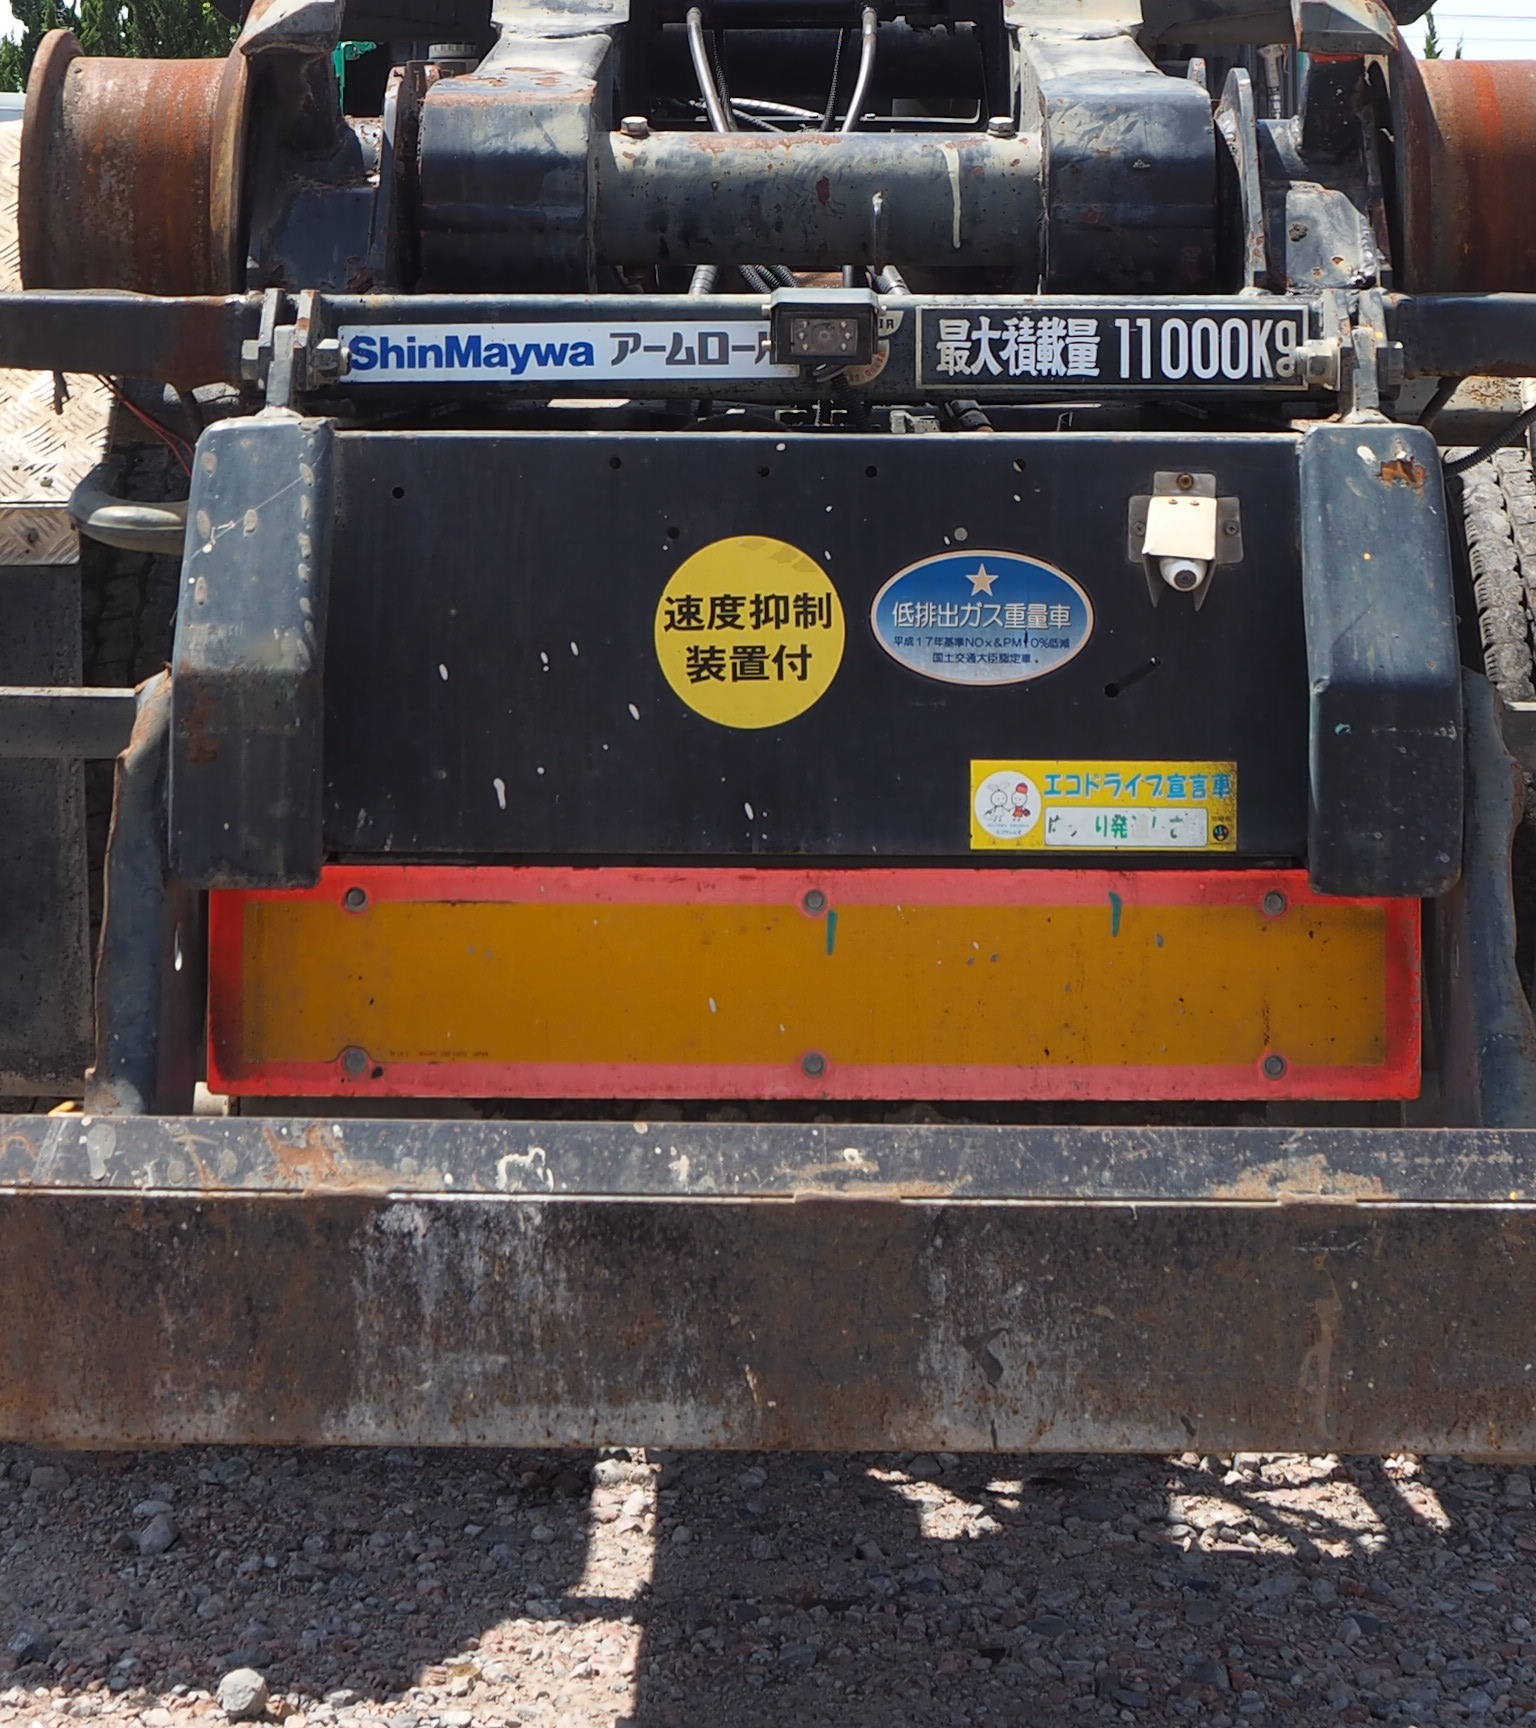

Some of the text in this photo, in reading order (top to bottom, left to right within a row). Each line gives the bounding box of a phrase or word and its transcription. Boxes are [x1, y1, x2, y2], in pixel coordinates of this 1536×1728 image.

[350, 334, 595, 375] ShinMaywa
[936, 316, 1101, 378] 最大積載量
[1114, 317, 1298, 380] 11000Kg
[663, 591, 833, 633] 速度抑制
[892, 601, 1073, 631] 低排出ガス重量車
[685, 643, 813, 684] 装置付
